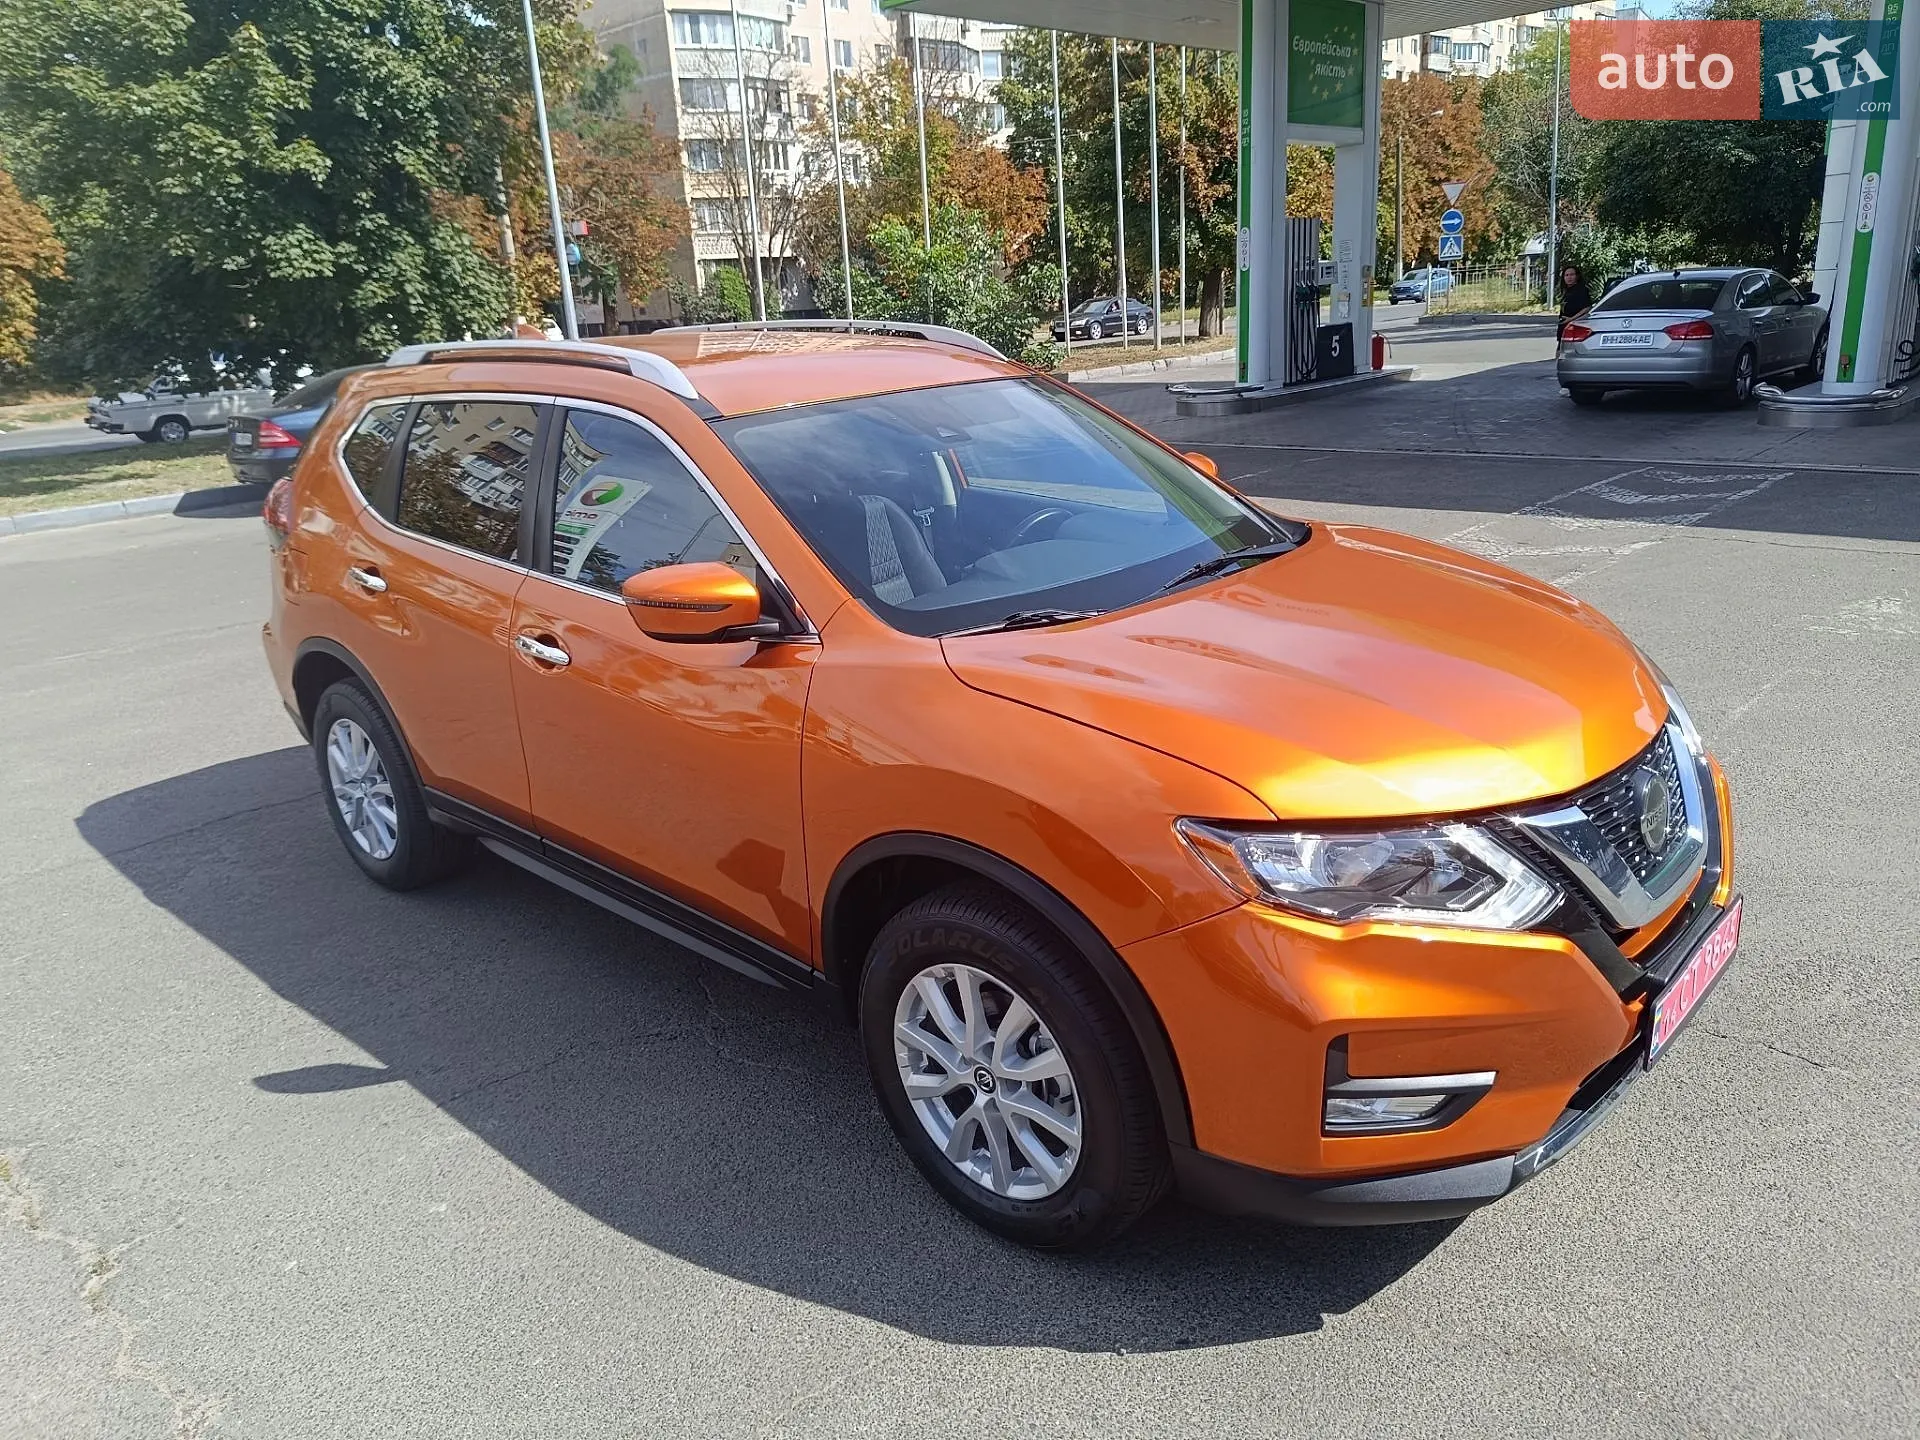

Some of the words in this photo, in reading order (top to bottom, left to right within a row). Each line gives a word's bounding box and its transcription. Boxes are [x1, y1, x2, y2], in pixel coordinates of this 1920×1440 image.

[1292, 35, 1352, 58] Європейська
[1314, 61, 1346, 78] якість
[1331, 335, 1340, 357] 5
